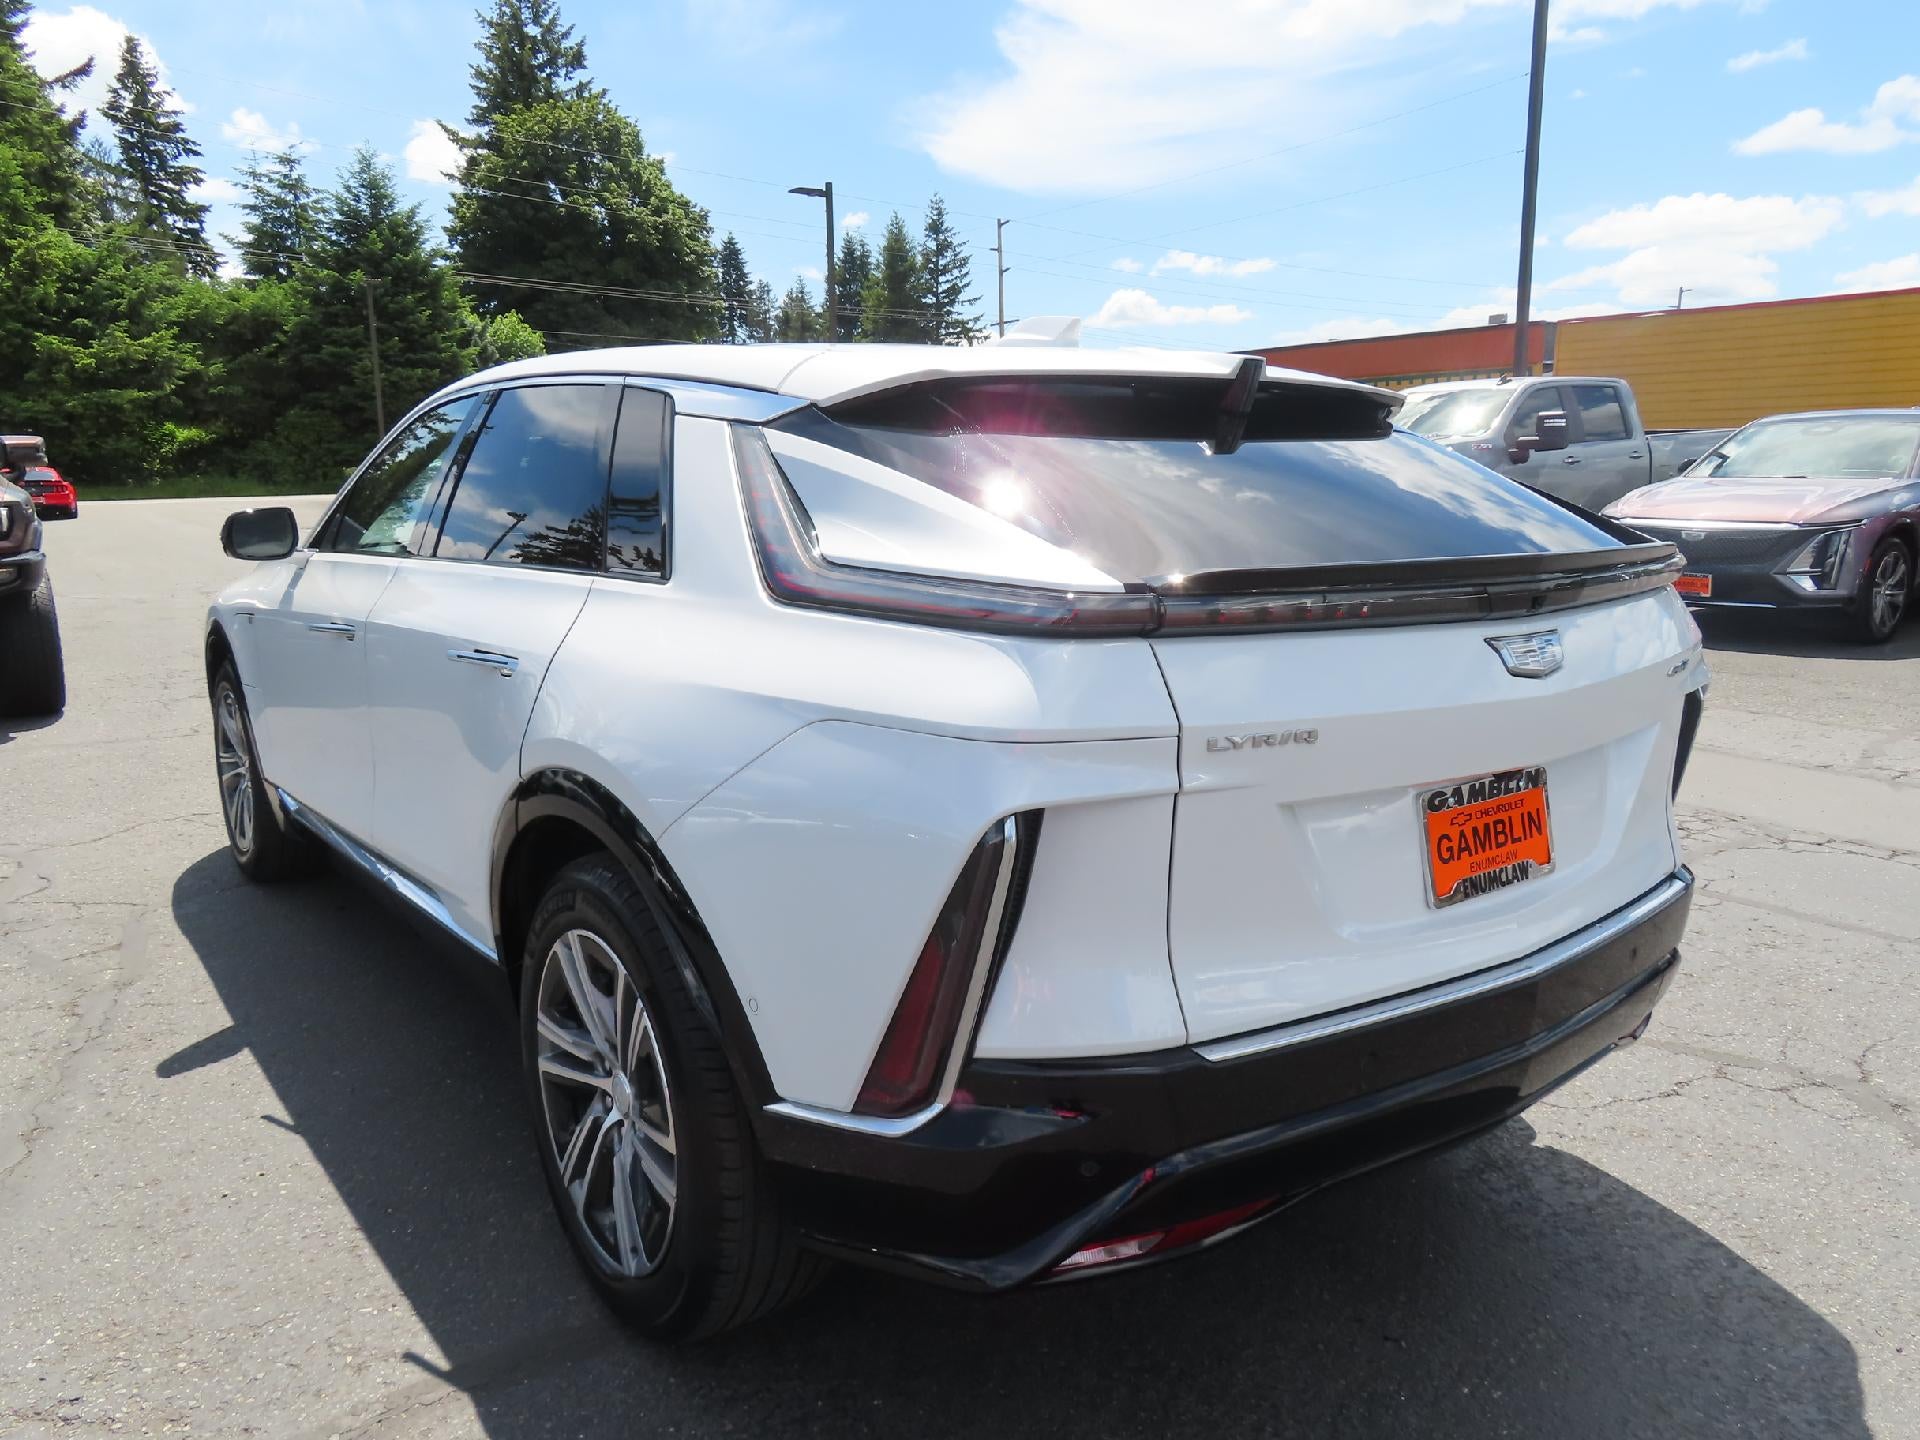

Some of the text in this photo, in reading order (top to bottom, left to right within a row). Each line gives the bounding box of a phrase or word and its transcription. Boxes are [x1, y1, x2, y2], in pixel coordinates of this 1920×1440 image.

[1475, 799, 1524, 820] CHEVROLET
[1437, 808, 1542, 864] GAMBLIN
[1470, 849, 1518, 873] ENUMCLAW
[1463, 861, 1530, 898] ENUMCLAW
